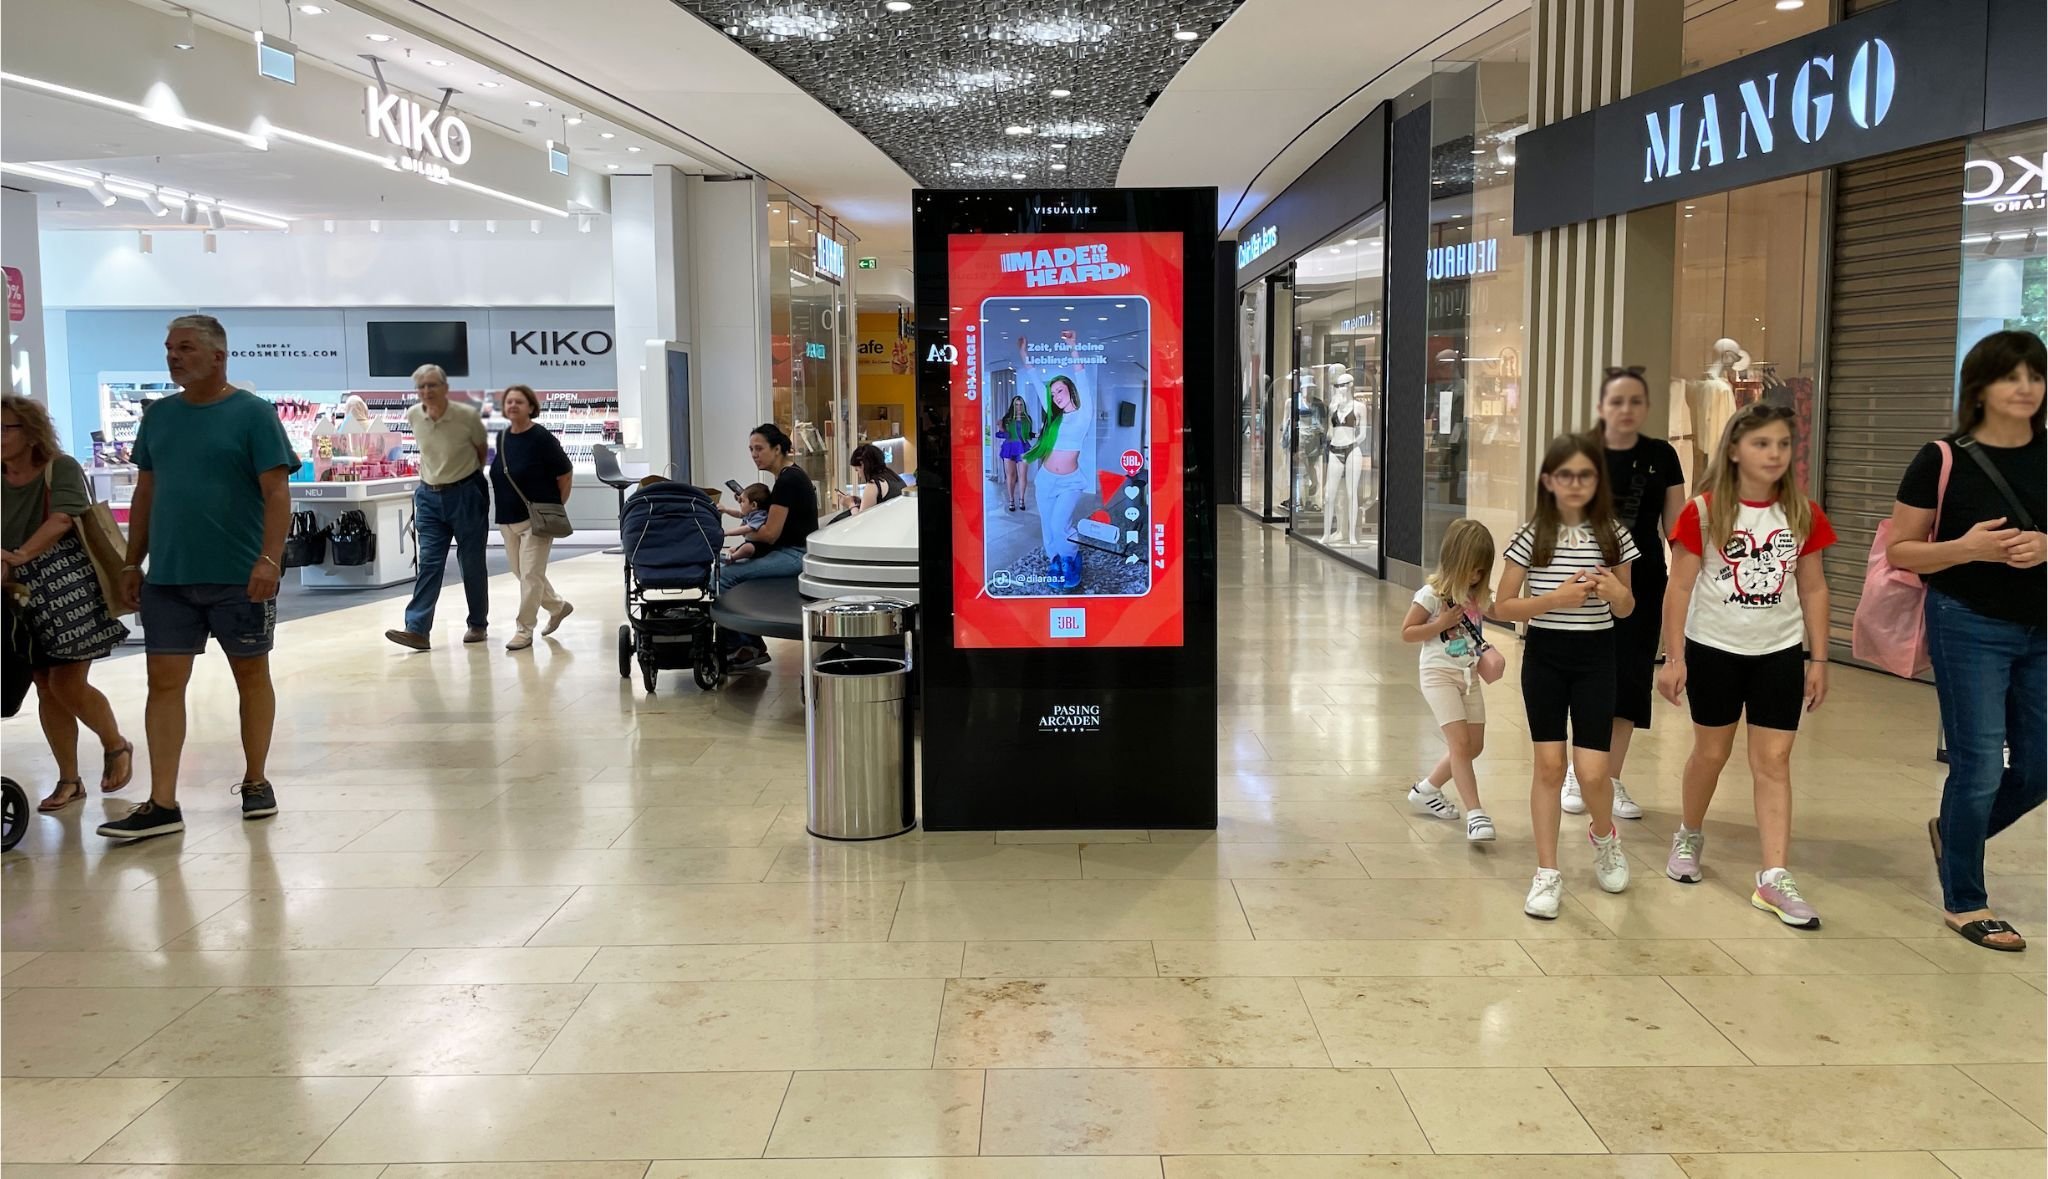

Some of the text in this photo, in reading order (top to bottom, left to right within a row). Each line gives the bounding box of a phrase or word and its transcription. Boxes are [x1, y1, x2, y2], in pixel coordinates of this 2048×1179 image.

[1643, 38, 1896, 183] MANGO
[367, 86, 471, 165] KIKO
[1033, 206, 1098, 214] VISUALART
[1003, 244, 1108, 272] MADE TO
[1092, 253, 1108, 263] BE
[1026, 262, 1122, 288] HEARD
[510, 330, 613, 355] KIKO
[1054, 342, 1072, 352] für
[1074, 342, 1105, 352] deine
[227, 350, 338, 358] OCOSMETICS.COM
[1025, 355, 1108, 366] Lieblingsmusik
[966, 335, 977, 401] CHARGE
[546, 392, 579, 401] LIPPEN
[1122, 455, 1141, 467] JBL
[305, 488, 323, 497] NEU
[1154, 523, 1165, 556] FLIP
[1154, 560, 1165, 569] 7
[1058, 616, 1079, 629] JBL
[1053, 704, 1100, 716] PASING
[1039, 715, 1100, 727] ARCADEN
